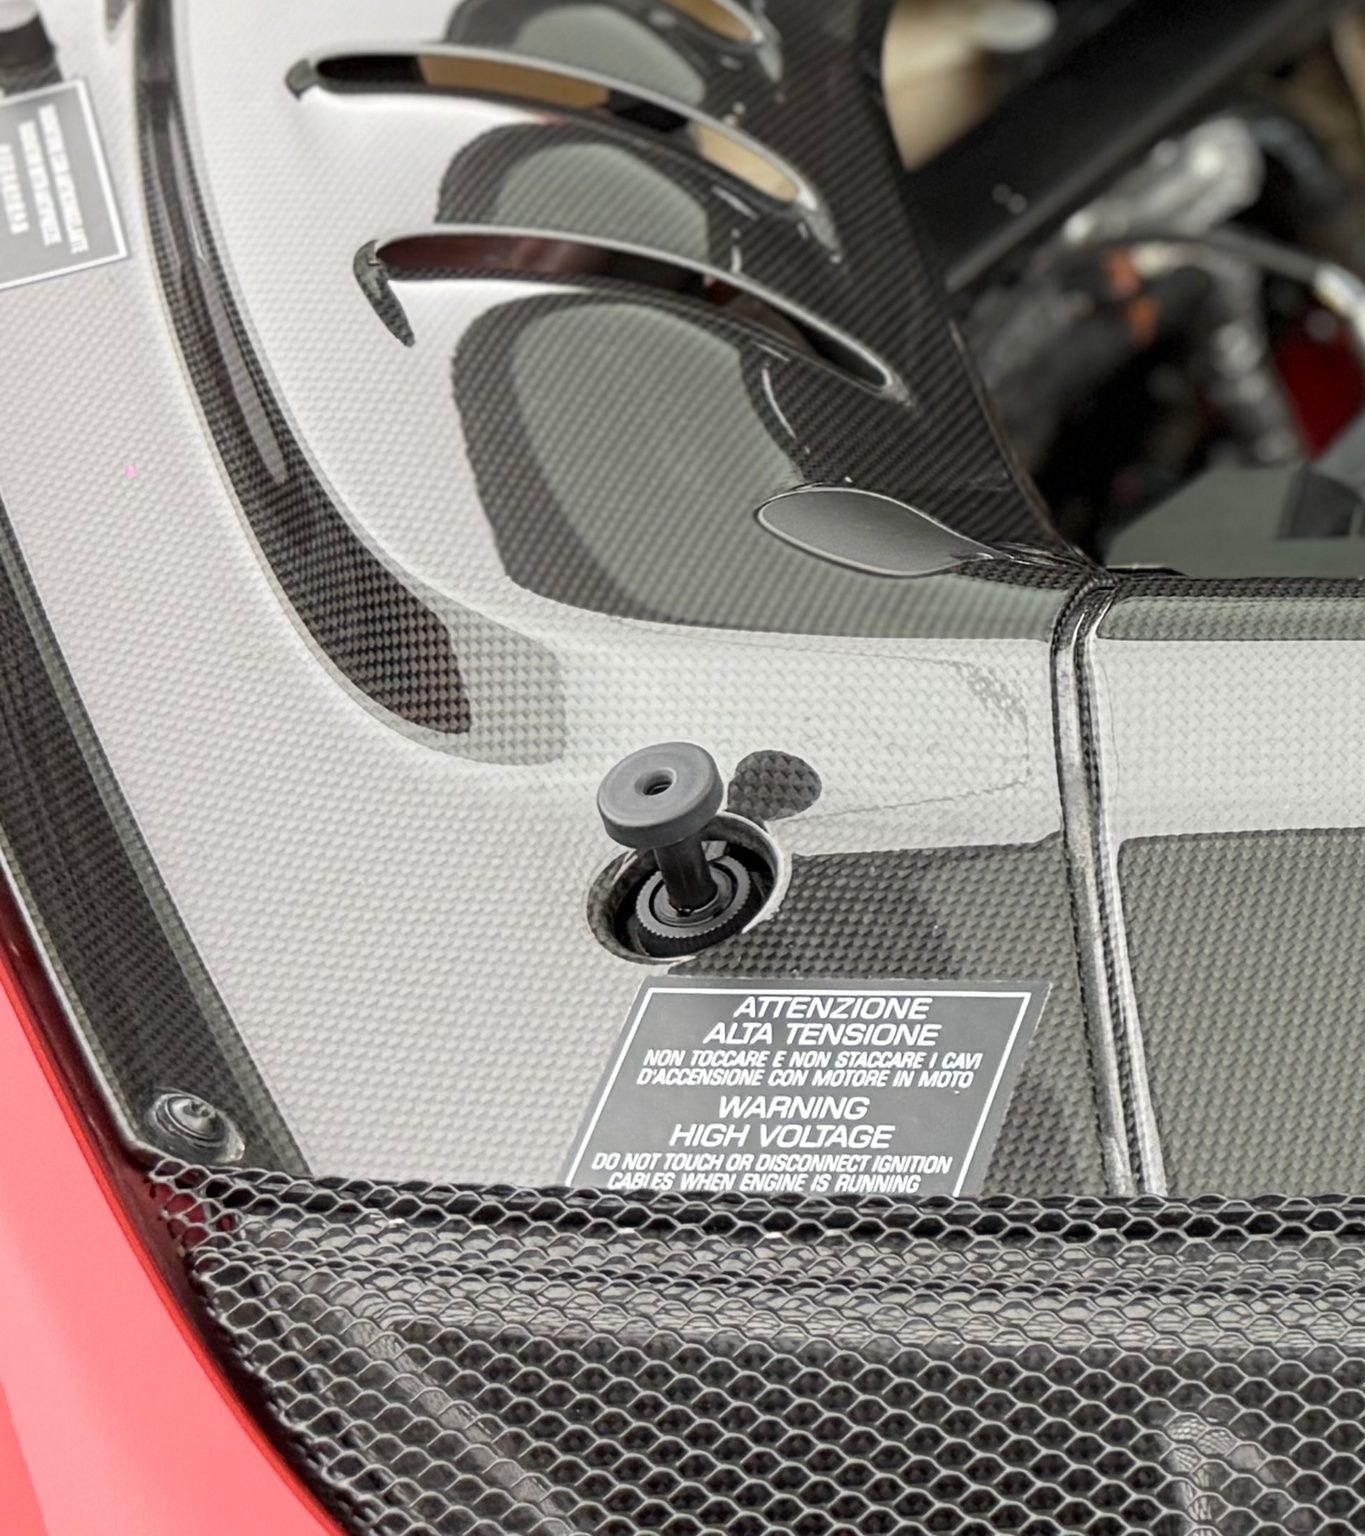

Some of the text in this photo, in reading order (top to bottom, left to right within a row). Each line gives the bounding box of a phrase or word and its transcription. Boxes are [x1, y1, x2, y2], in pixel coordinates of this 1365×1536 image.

[733, 996, 933, 1020] ATTENZIONE
[703, 1022, 942, 1046] ALTA TENSIONE
[643, 1049, 984, 1070] NON TOCCARE E NON STACCARE I CAVI
[636, 1068, 975, 1088] D'ACCENSIONE CON MOTORE IN MOTO
[718, 1095, 870, 1120] WARNING
[669, 1123, 896, 1148] HIGH VOLTAGE
[591, 1152, 953, 1174] DO NOT TOUCH OR DISCONNECT IGNITION
[607, 1172, 922, 1193] CABLES WHEN ENGINE IS RUNNING
